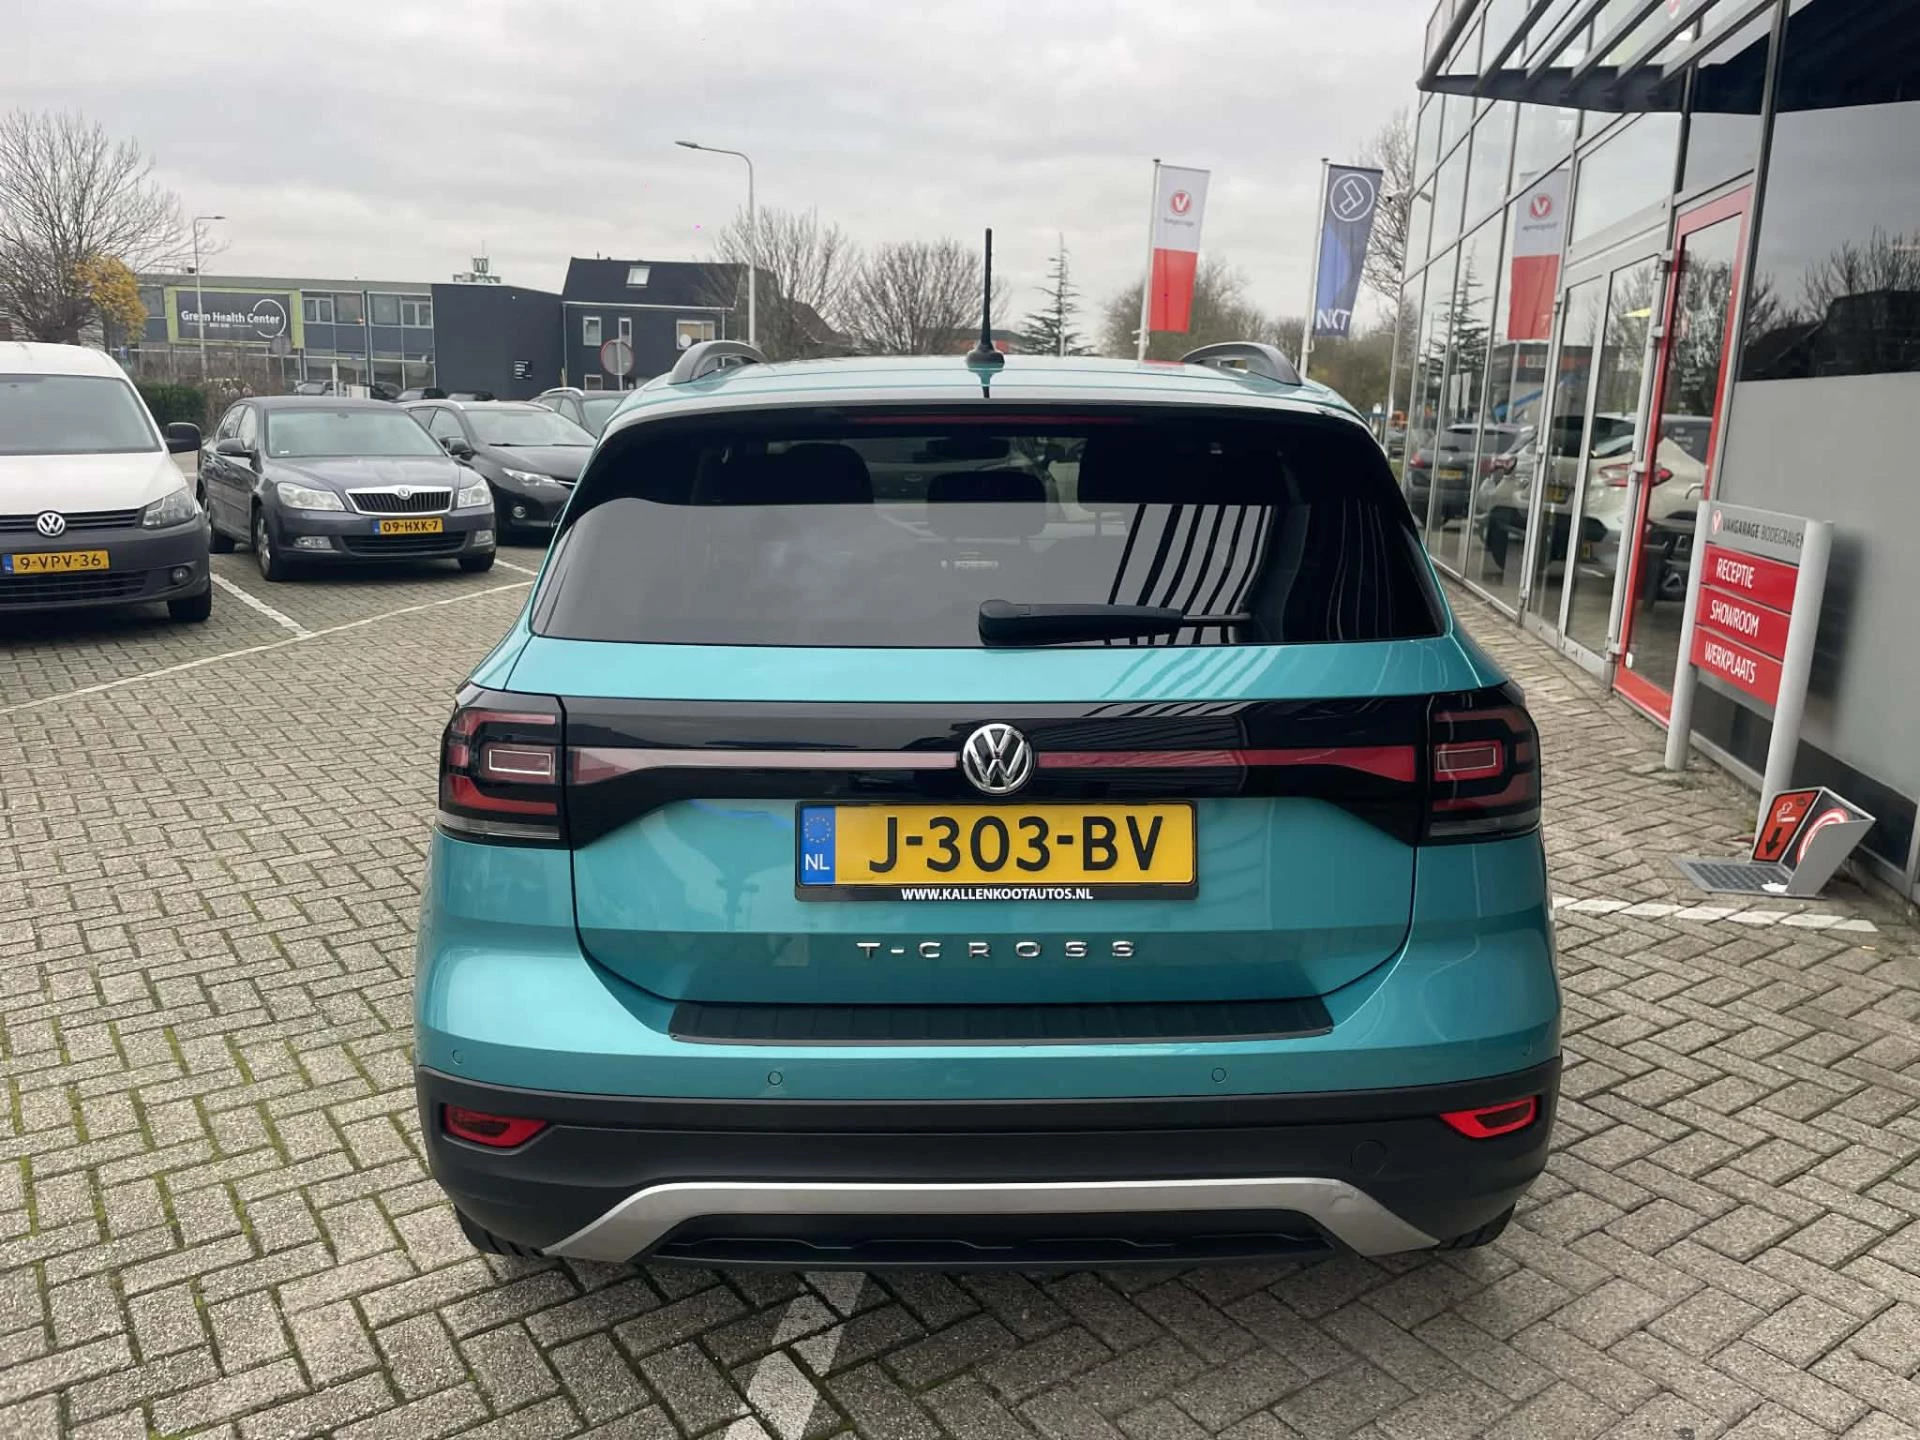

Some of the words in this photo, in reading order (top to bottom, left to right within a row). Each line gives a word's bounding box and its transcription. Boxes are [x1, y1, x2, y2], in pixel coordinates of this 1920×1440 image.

[181, 310, 211, 321] Gren
[212, 312, 246, 322] Health
[246, 313, 280, 324] Center
[382, 520, 438, 532] 09-HXK-7
[20, 553, 102, 570] 9-VPV-36
[1716, 558, 1755, 589] RECEPTIE
[1710, 600, 1760, 638] SHOWROOM
[1704, 641, 1757, 684] WERKPLAATS
[869, 815, 1163, 873] J-303-BV
[804, 853, 831, 871] NL
[901, 887, 1094, 901] WWW.KALLENKOOTAUTOS.NL
[856, 941, 1136, 959] T-CROSS
